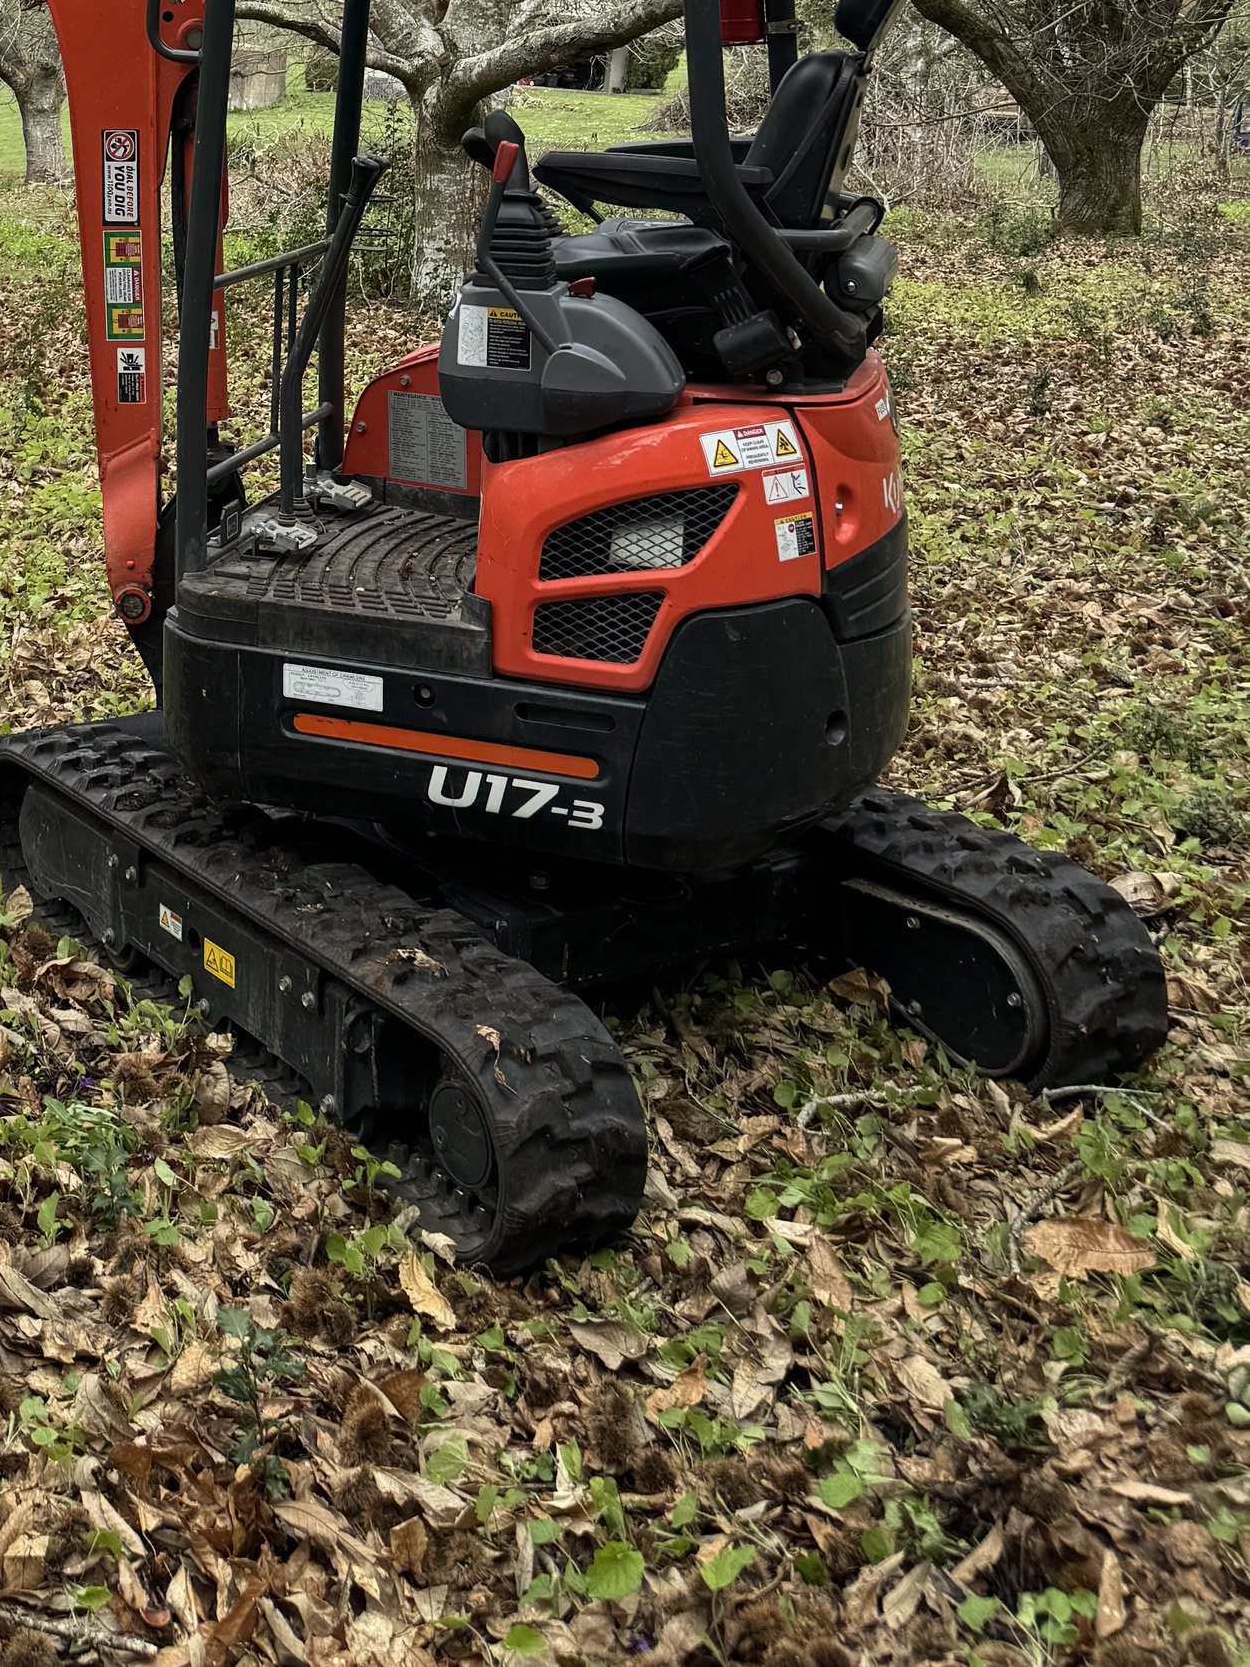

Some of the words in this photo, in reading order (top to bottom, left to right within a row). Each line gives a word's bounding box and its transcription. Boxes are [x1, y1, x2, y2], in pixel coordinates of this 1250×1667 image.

[114, 165, 125, 192] YOU
[126, 165, 135, 184] DIAL
[114, 194, 125, 217] DIG
[126, 186, 134, 218] BEFORE
[743, 428, 763, 436] DANGER
[428, 765, 605, 830] U17-3
